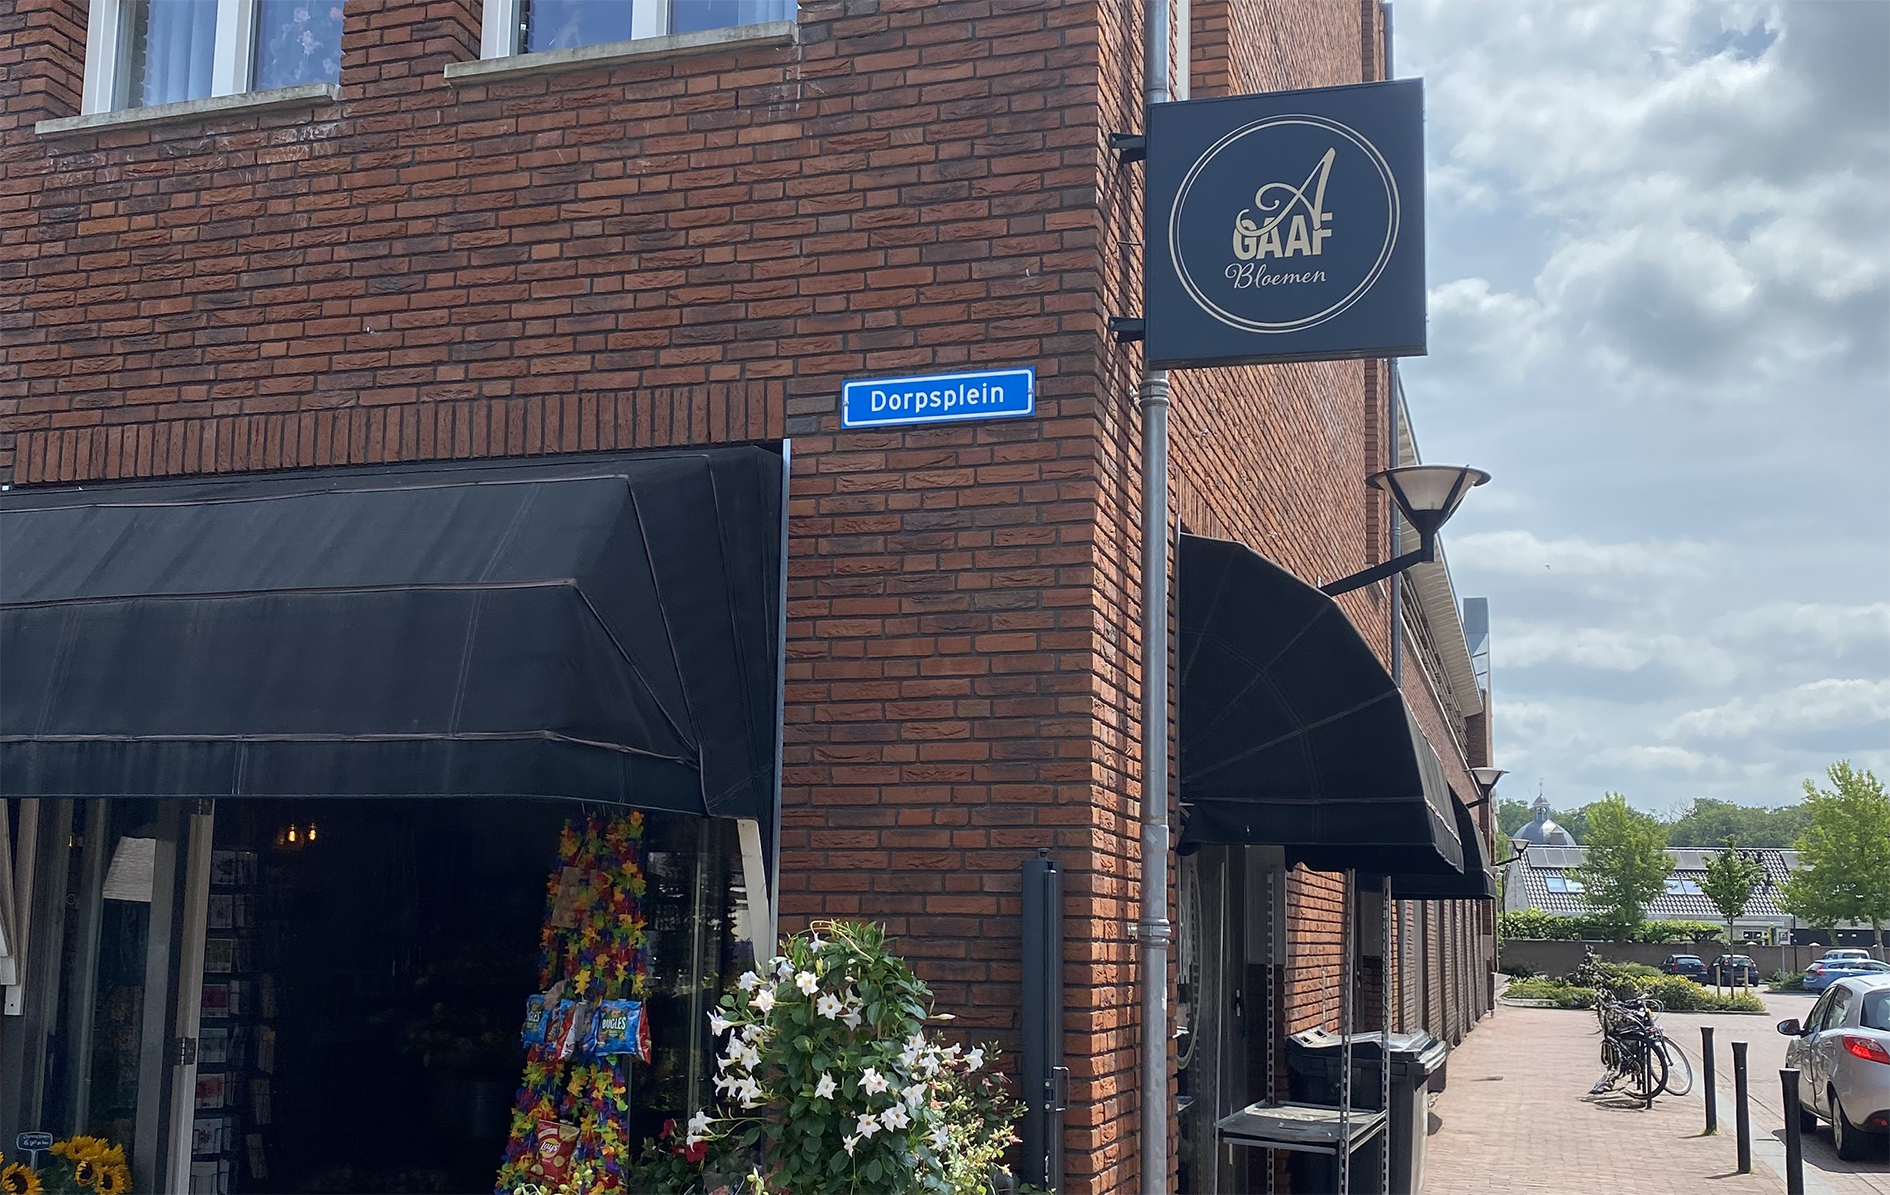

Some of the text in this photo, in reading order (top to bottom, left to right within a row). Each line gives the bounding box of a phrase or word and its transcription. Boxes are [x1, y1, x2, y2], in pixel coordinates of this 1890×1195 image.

[1233, 212, 1333, 260] GAAF
[1225, 263, 1326, 289] Bloemen
[871, 383, 1004, 413] Dorpsplein
[602, 1017, 627, 1030] BUGLES
